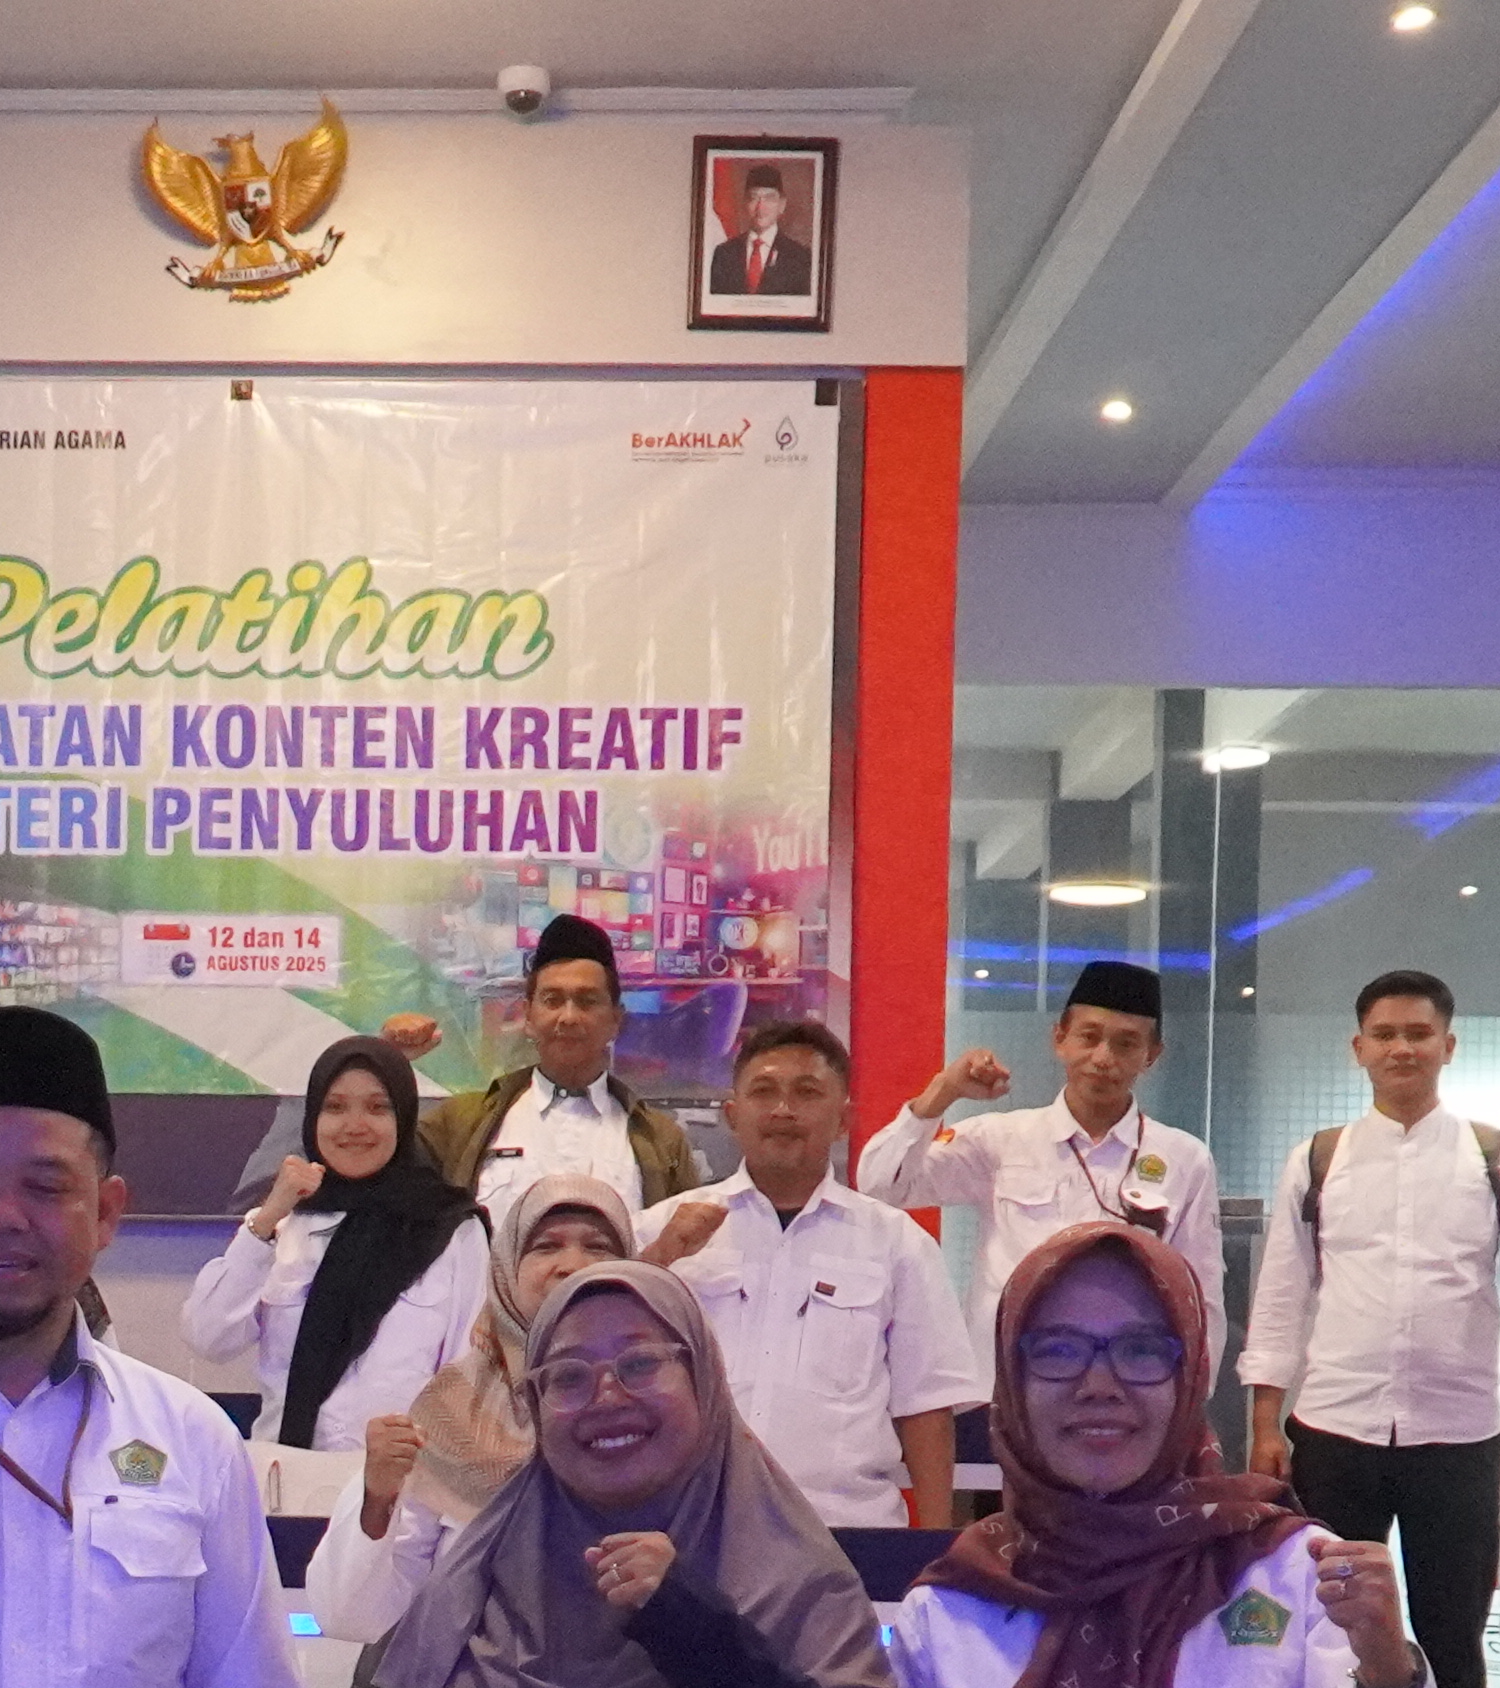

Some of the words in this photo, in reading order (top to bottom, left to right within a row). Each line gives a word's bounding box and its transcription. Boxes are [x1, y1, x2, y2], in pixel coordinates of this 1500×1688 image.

[53, 429, 127, 451] AGAMA
[631, 432, 745, 449] BerAKHLAK
[172, 703, 435, 770] KONTEN
[464, 706, 744, 772] KREATIF
[151, 785, 599, 854] PENYULUHAN
[752, 823, 829, 873] YouT
[208, 925, 235, 948] 12
[243, 926, 285, 949] dan
[294, 926, 322, 949] 14
[206, 955, 280, 972] AGUSTUS
[285, 956, 326, 972] 2025
